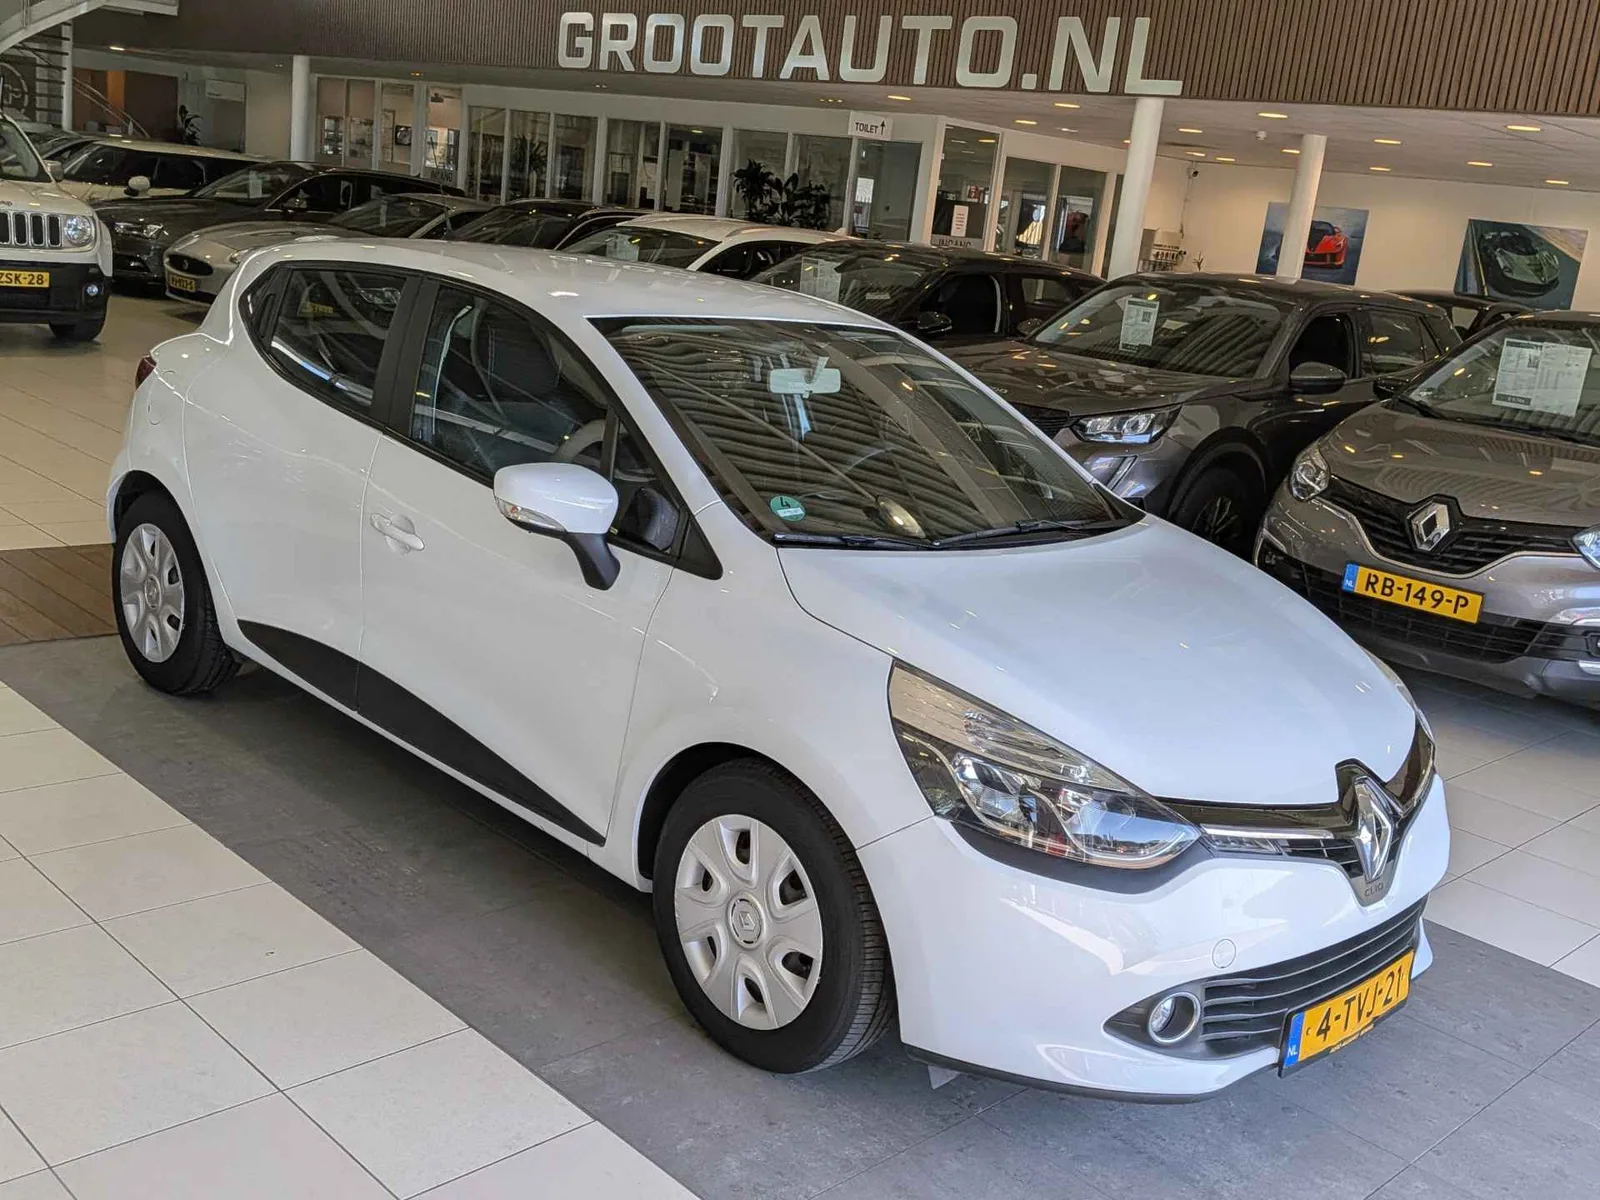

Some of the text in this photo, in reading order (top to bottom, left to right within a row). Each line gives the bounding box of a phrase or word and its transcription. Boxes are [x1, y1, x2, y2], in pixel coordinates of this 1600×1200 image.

[557, 11, 1184, 96] GROOTAUTO.NL
[855, 122, 879, 135] TOILET
[1364, 572, 1469, 615] RB-149-P
[1364, 882, 1384, 897] CLIO
[1316, 965, 1404, 1043] 4-TVJ-21
[1287, 1044, 1299, 1057] NL
